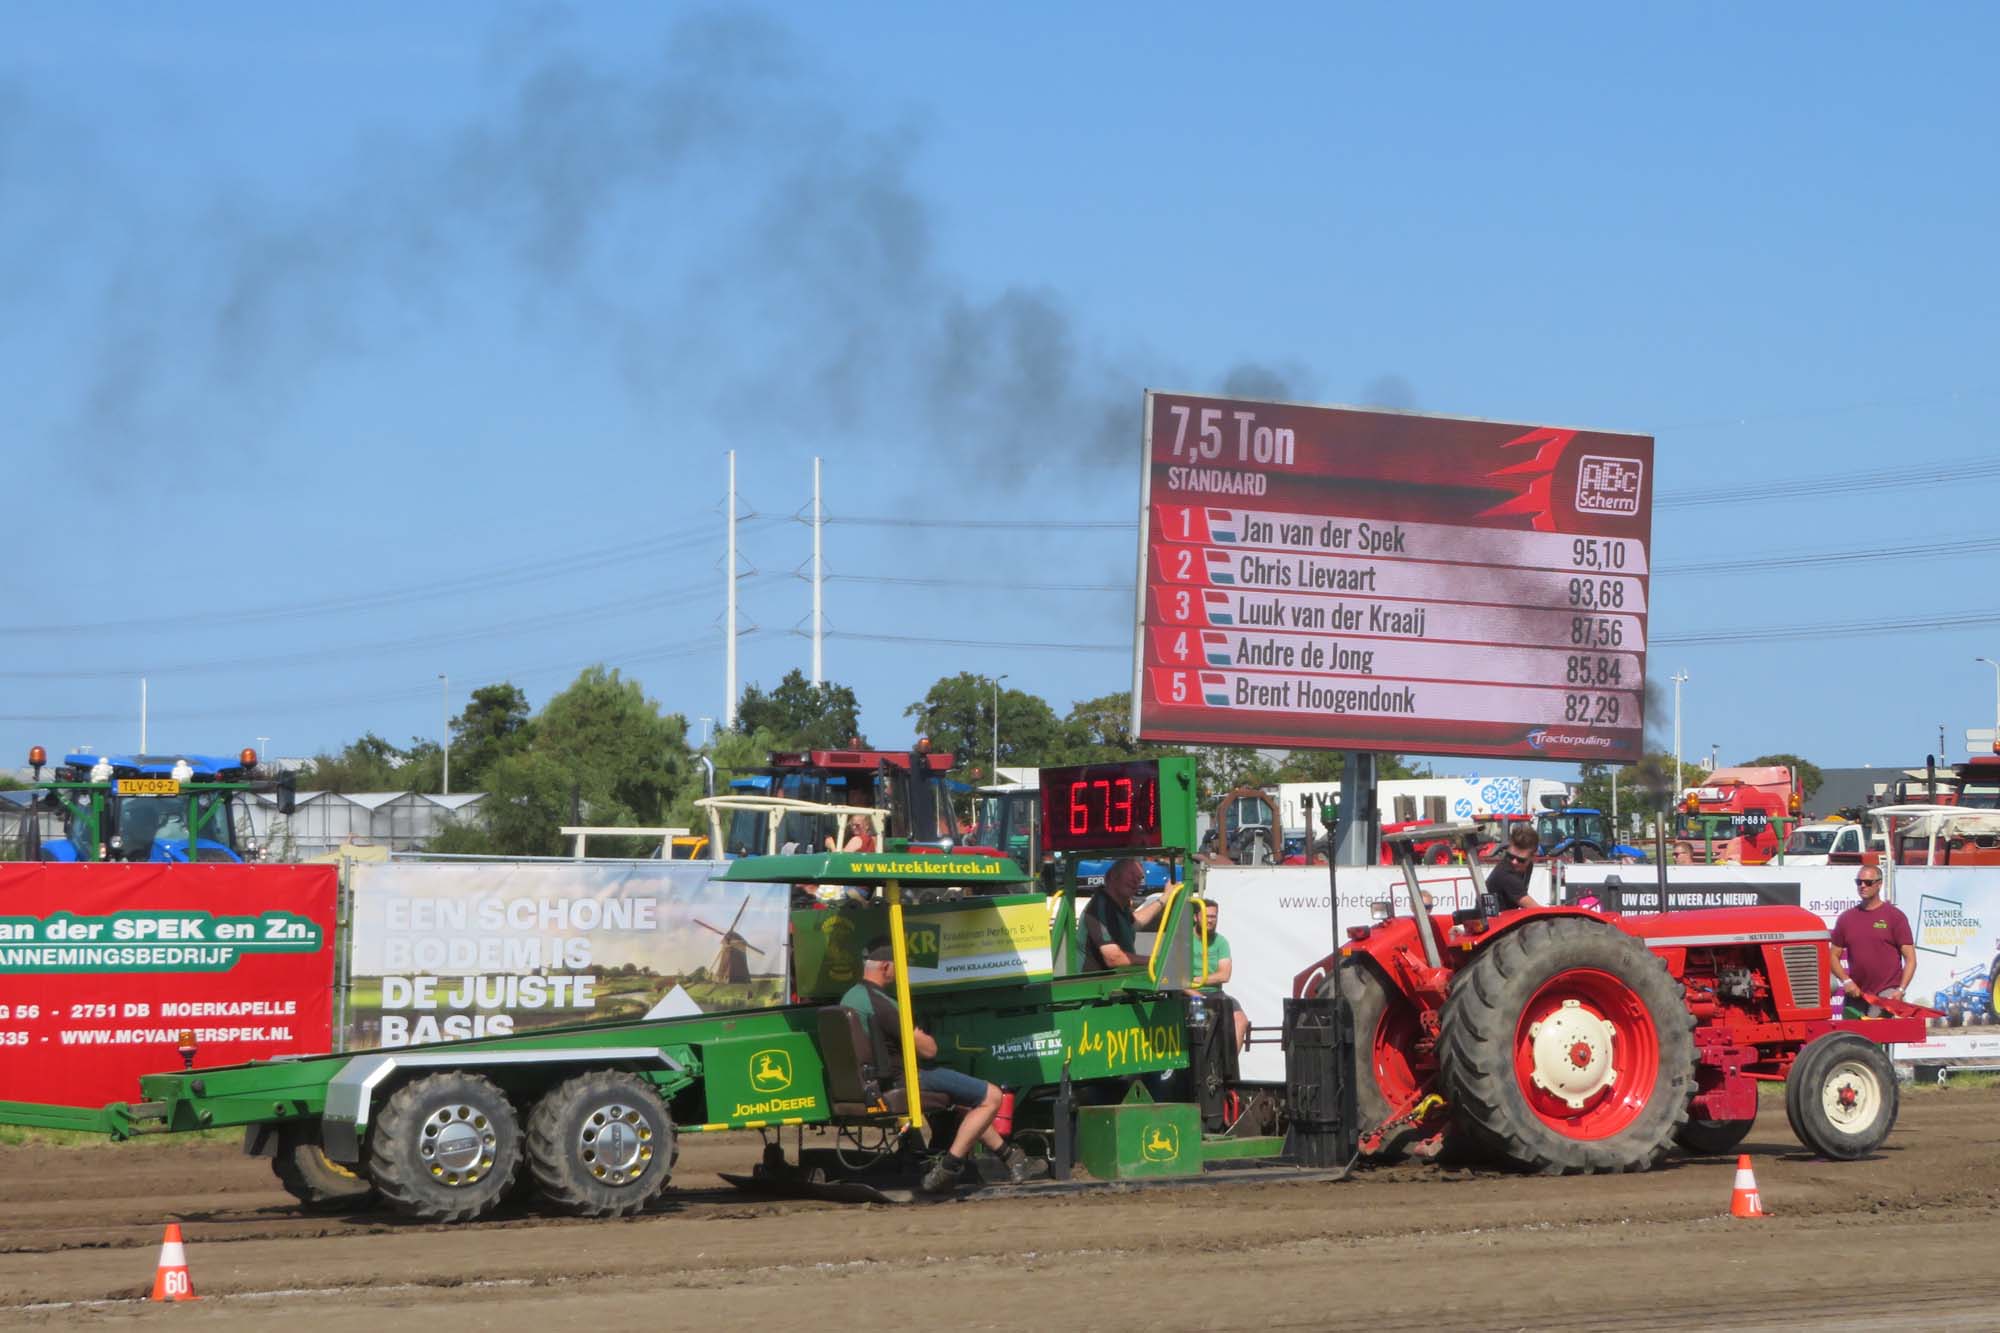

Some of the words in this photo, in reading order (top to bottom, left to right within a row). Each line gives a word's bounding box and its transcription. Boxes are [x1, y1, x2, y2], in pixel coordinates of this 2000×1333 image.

[1170, 405, 1222, 464] 7,5
[1233, 411, 1295, 465] Ton
[1168, 466, 1267, 497] STANDAARD
[1579, 491, 1634, 510] Scherm
[1180, 507, 1190, 537] 1
[1240, 514, 1273, 543] Jan
[1279, 521, 1314, 545] van
[1320, 519, 1352, 548] der
[1358, 523, 1405, 554] Spek
[1573, 538, 1625, 570] 95,10
[1176, 549, 1191, 580] 2
[1240, 555, 1292, 586] Chris
[1299, 560, 1376, 592] Lievaart
[1569, 578, 1624, 610] 93,68
[1175, 591, 1190, 621] 3
[1239, 596, 1285, 626] Luuk
[1292, 606, 1325, 628] van
[1331, 602, 1363, 630] der
[1370, 604, 1425, 637] Kraaij
[1571, 617, 1622, 648] 87,56
[1173, 632, 1188, 661] 4
[1236, 637, 1294, 666] Andre
[1301, 641, 1323, 669] de
[1329, 642, 1374, 674] Jong
[1566, 655, 1621, 687] 85,84
[1172, 672, 1187, 702] 5
[1235, 677, 1297, 706] Brent
[1297, 681, 1416, 713] Hoogendonk
[1564, 694, 1620, 727] 82,29
[1526, 731, 1611, 747] Tractorpulling
[122, 781, 175, 792] TLV-09-Z
[850, 860, 1000, 874] www.trekkertrek.nl
[1621, 893, 1638, 906] UW
[1677, 893, 1703, 906] WEER
[1704, 893, 1721, 906] ALS
[1722, 893, 1759, 906] NIEUW?
[385, 898, 466, 930] EEN
[478, 897, 657, 930] SCHONE
[1923, 909, 1963, 918] TECHNIEK
[1924, 919, 1941, 927] VAN
[46, 919, 104, 940] der
[113, 918, 205, 940] SPEK
[215, 923, 255, 939] en
[265, 918, 316, 939] Zn.
[385, 937, 540, 970] BODEM
[552, 936, 592, 969] IS
[382, 975, 438, 1009] DE
[449, 975, 596, 1009] JUISTE
[16, 1004, 41, 1019] 56
[70, 1003, 116, 1018] 2751
[123, 1003, 150, 1017] DB
[161, 1001, 296, 1017] MOERKAPELLE
[60, 1027, 293, 1045] WWW.MCVANERSPEK.NL
[1022, 1039, 1046, 1051] VLIET
[1106, 1024, 1182, 1069] PYTHON
[732, 1103, 770, 1117] JOHN
[770, 1096, 816, 1111] DEERE
[165, 1270, 188, 1294] 60
